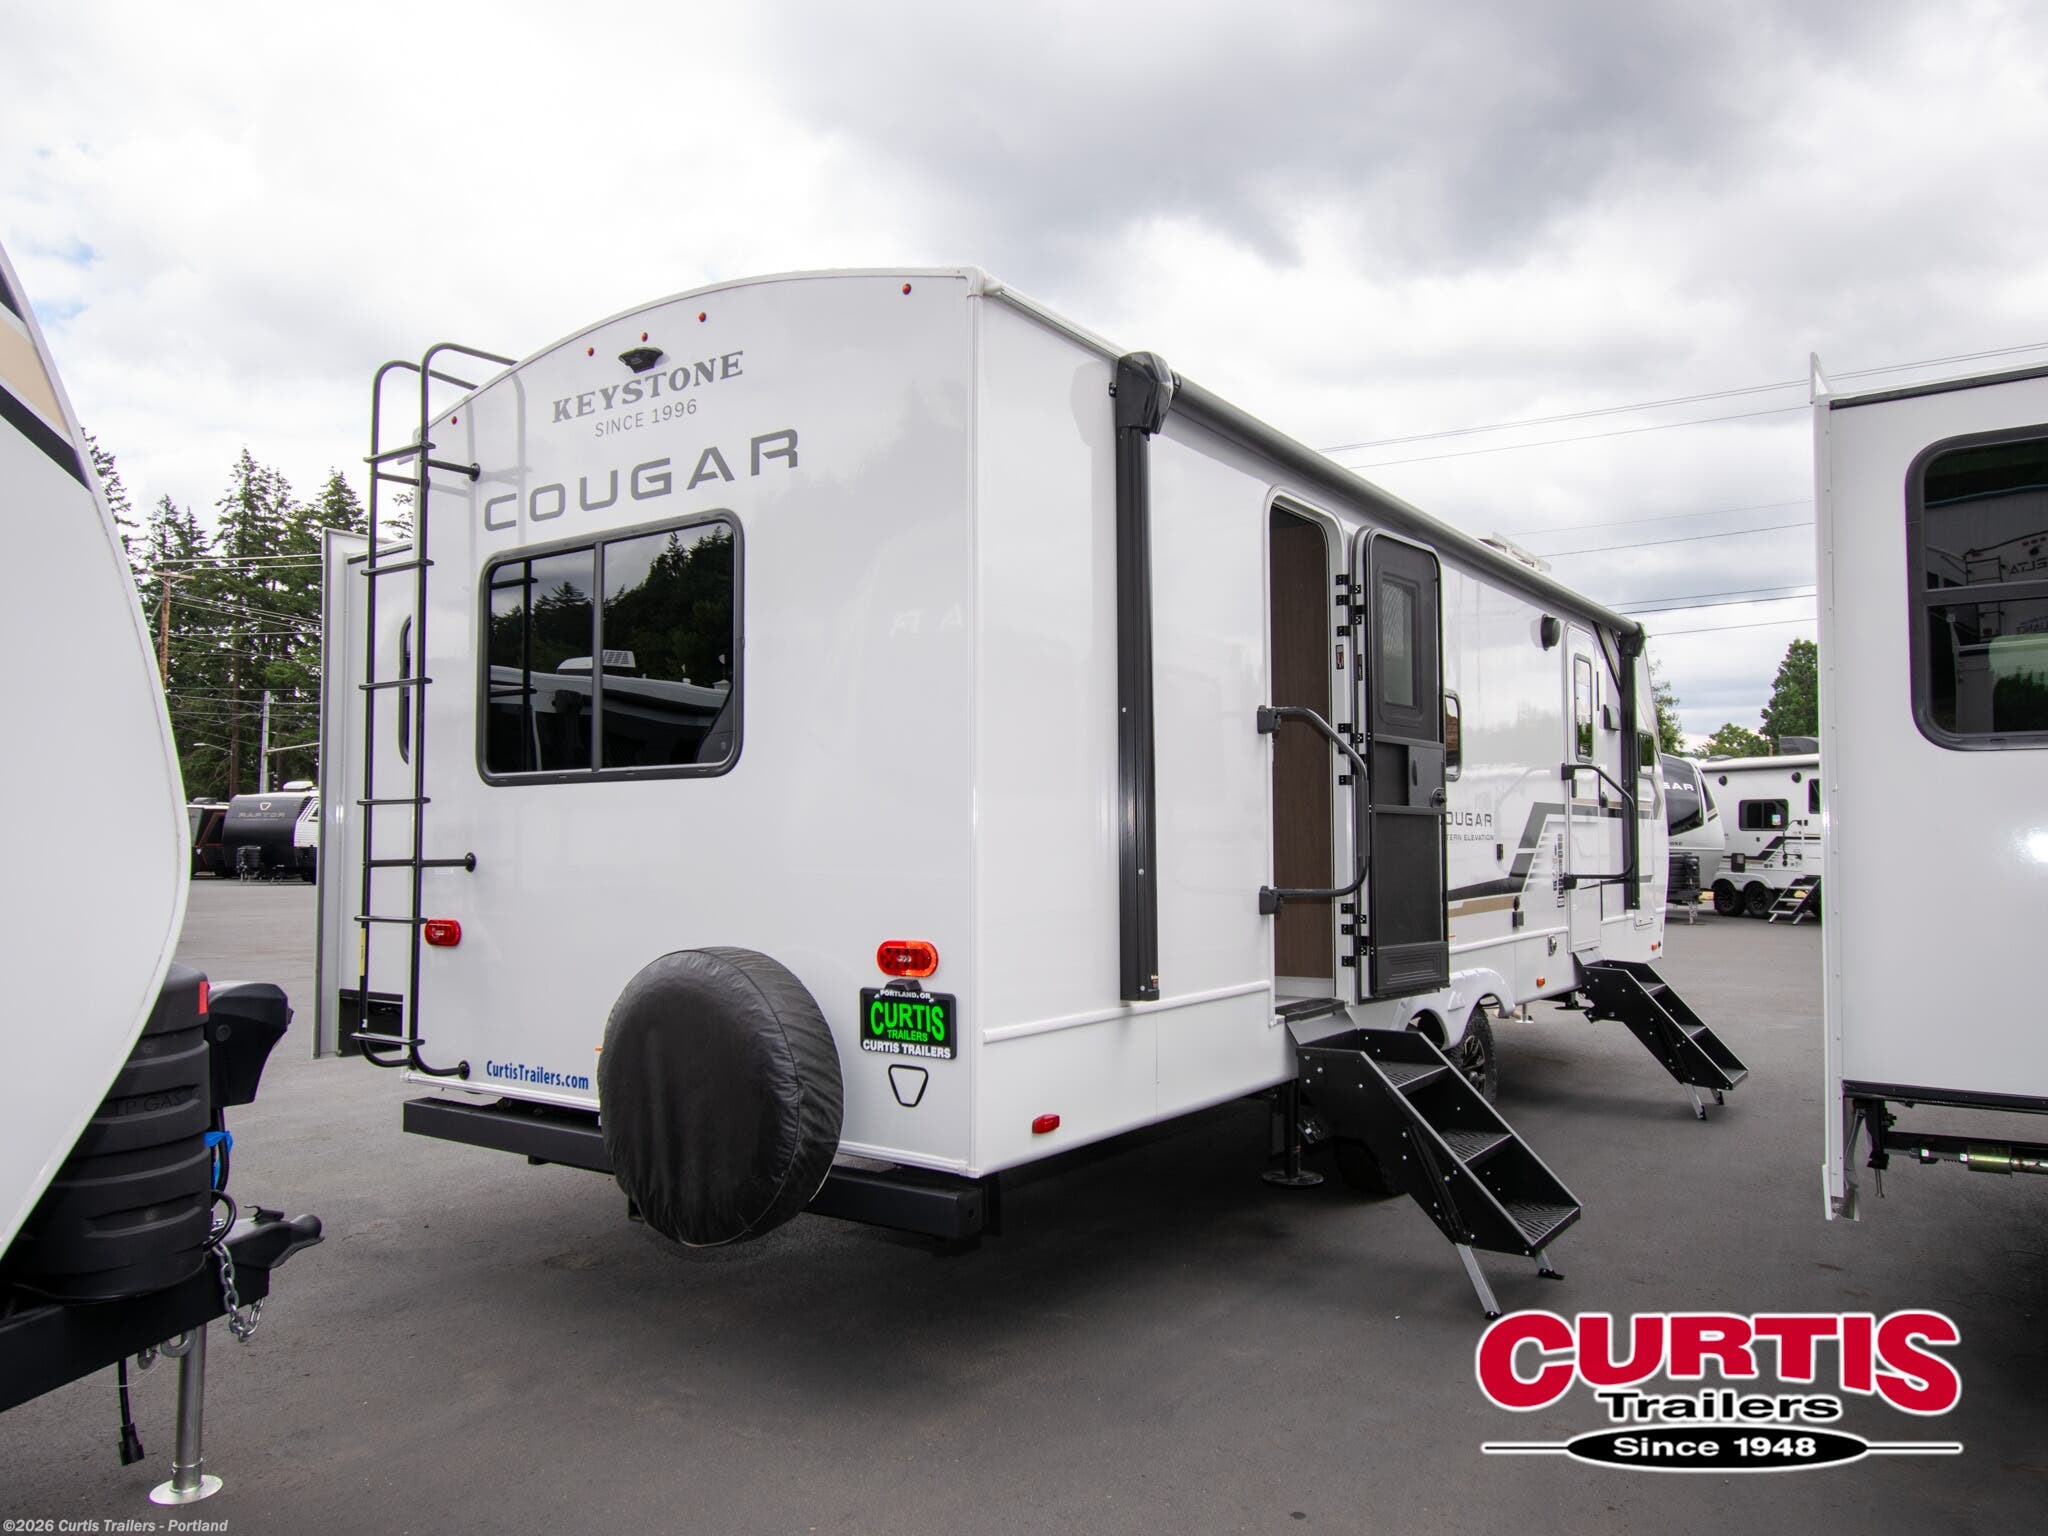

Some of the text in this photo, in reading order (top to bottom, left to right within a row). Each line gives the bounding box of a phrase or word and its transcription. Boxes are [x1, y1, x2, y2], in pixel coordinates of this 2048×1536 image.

[552, 350, 744, 424] KEYSTONE
[595, 398, 698, 438] SINCE 1996
[484, 428, 799, 532] COUGAR
[1445, 811, 1492, 828] OUGAR
[919, 992, 931, 1000] OR
[870, 1000, 945, 1042] CURTIS
[886, 1029, 928, 1042] TRAILERS
[862, 1039, 952, 1059] CURTIS TRAILERS
[486, 1060, 589, 1090] CurtisTrailers.com
